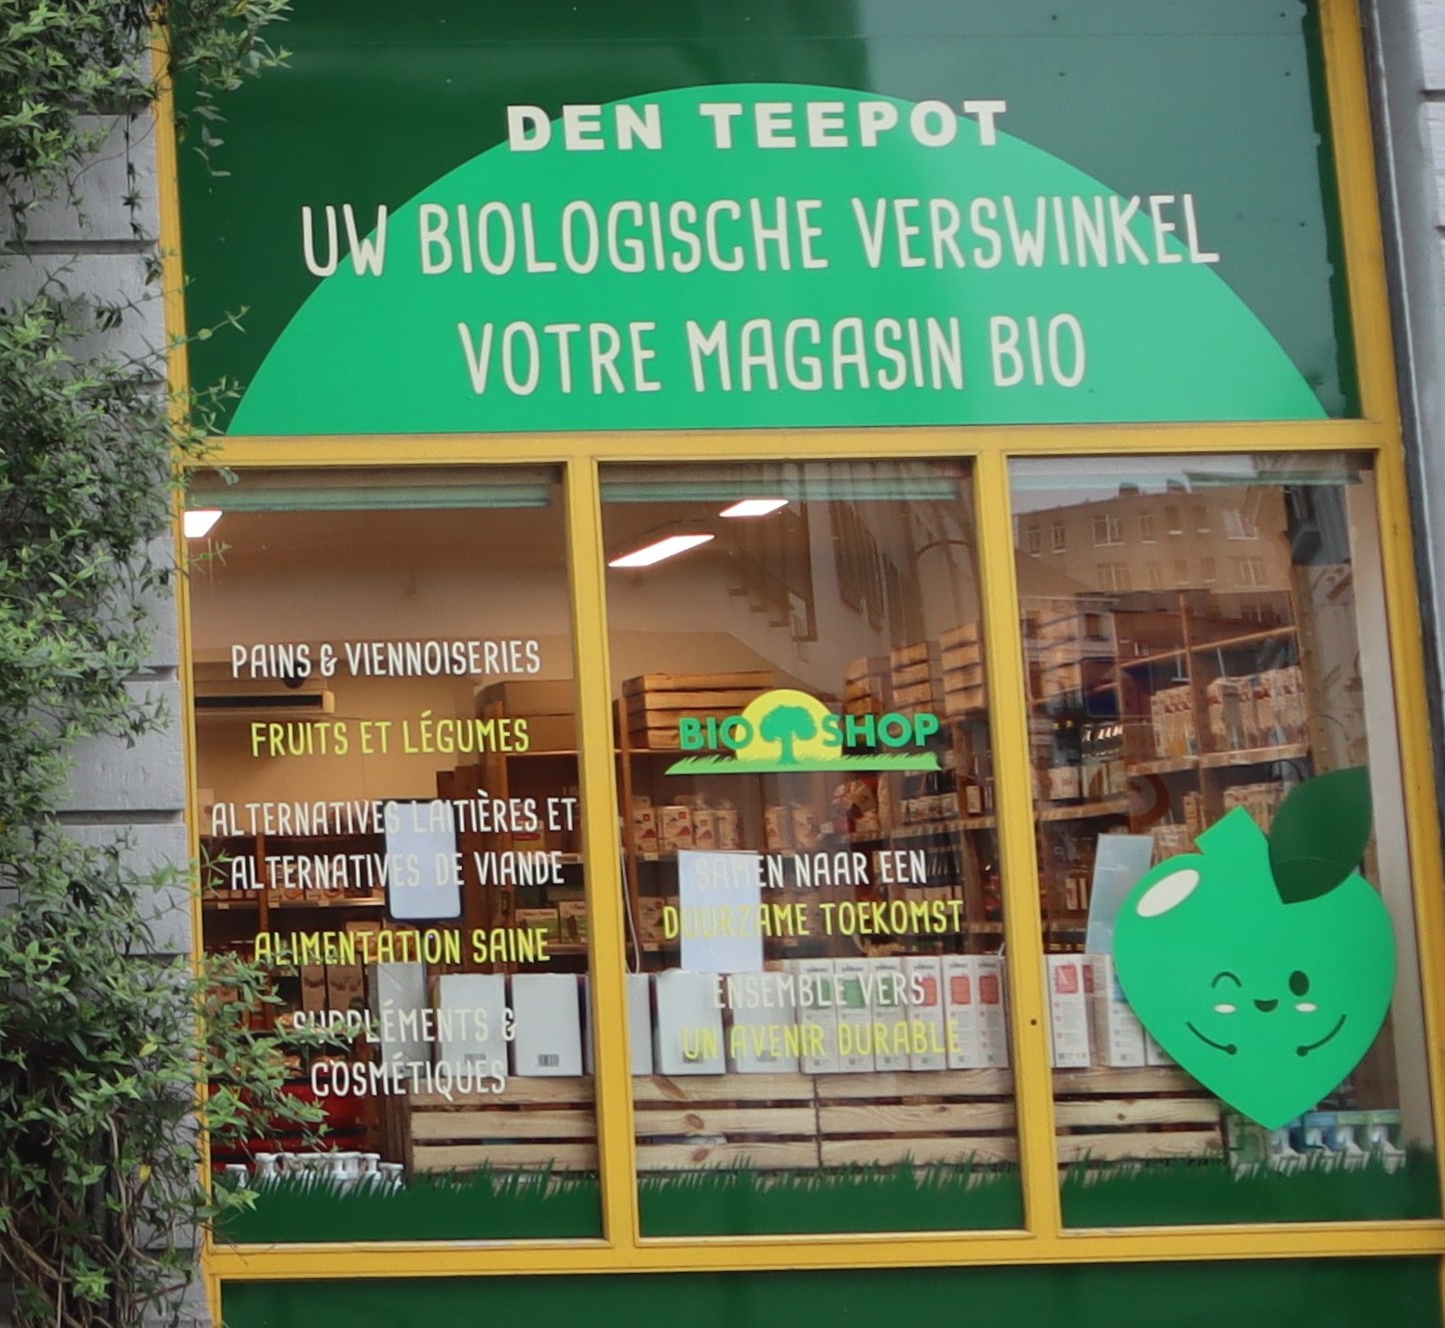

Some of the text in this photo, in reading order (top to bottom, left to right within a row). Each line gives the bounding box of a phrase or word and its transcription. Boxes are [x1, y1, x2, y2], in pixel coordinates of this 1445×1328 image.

[506, 100, 1007, 151] DEN TEEPOT
[300, 194, 1220, 277] UW BIOLOGISCHE VERSWINKEL
[457, 313, 1087, 397] VOTRE MAGASIN BIO
[231, 640, 541, 678] PAINS & VIENNOISERIES
[250, 710, 530, 756] FRUITS ET LÉGUMES
[678, 713, 939, 751] BIO SHOP
[212, 789, 577, 838] ALTERNATIVES LAITIÈRES ET
[231, 850, 565, 890] ALTERNATIVES DE VIANDE
[695, 849, 927, 889] SAMEN NAAR EEN
[663, 899, 964, 940] DUURZAME TOEKOMST
[254, 927, 550, 967] ALIMENTATION SAINE
[713, 971, 925, 1009] ENSEMBLE VERS
[292, 1000, 518, 1044] SUPPLÉMENTS &
[680, 1020, 962, 1060] UN AVENIR DURABLE
[311, 1052, 506, 1102] COSMÉTIQUES
